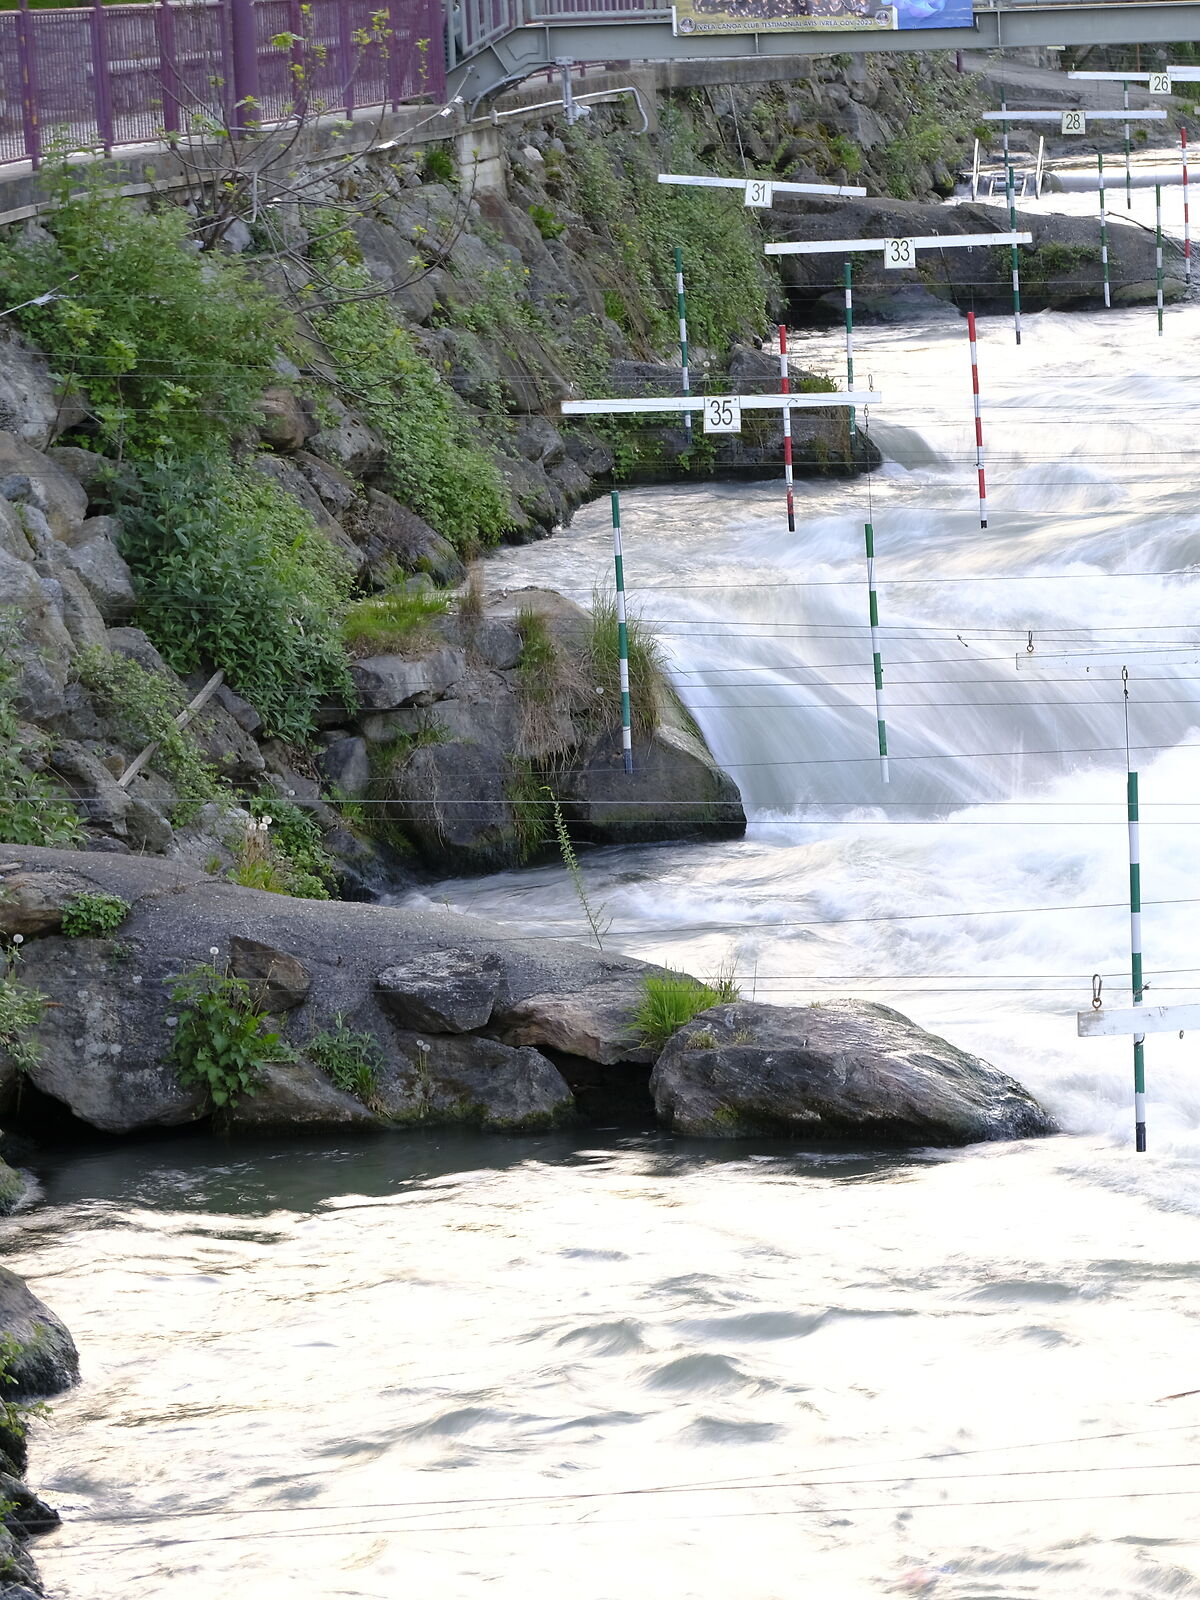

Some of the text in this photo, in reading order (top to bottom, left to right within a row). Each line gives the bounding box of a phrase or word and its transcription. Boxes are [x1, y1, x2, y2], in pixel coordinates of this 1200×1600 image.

[717, 22, 742, 30] CANOA
[743, 21, 760, 29] CLUB
[761, 20, 802, 29] TESTIMONIAL
[1154, 75, 1169, 91] 26
[1066, 113, 1081, 130] 28
[751, 182, 766, 202] 31
[890, 240, 910, 262] 33
[710, 399, 733, 426] 35
